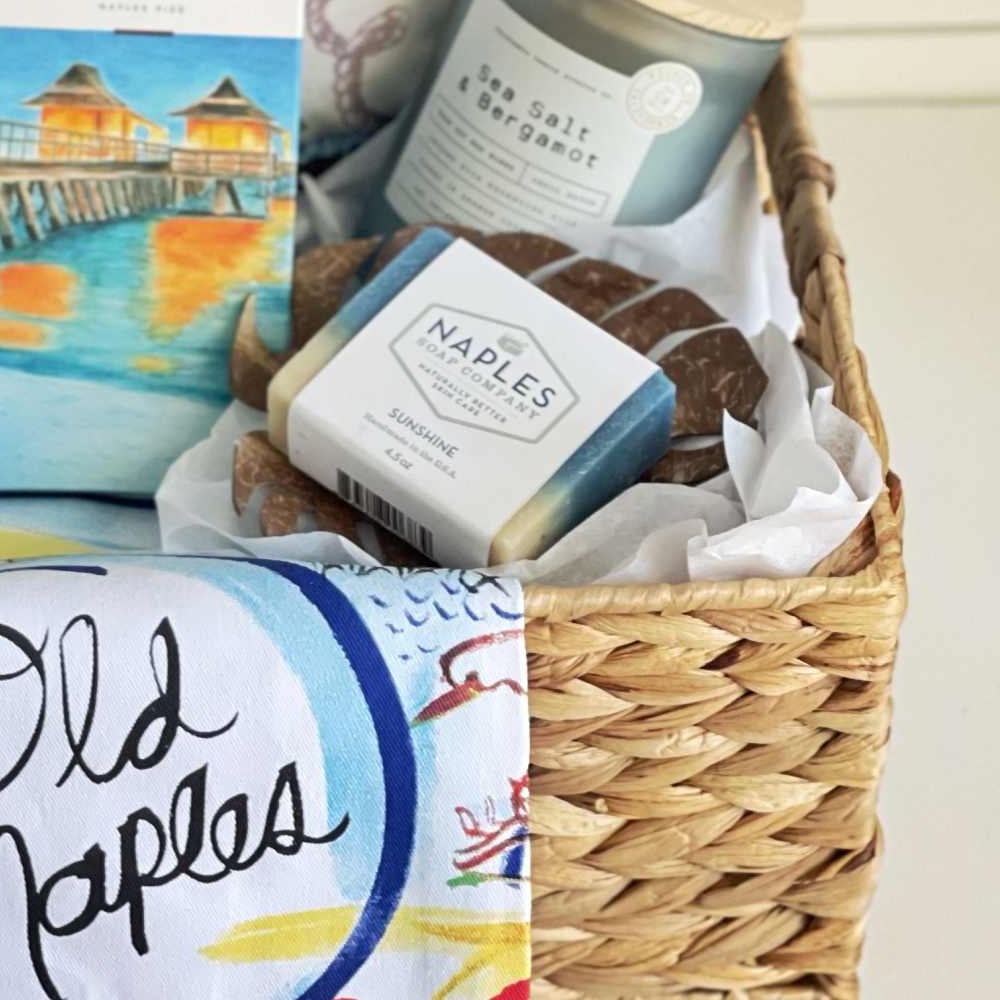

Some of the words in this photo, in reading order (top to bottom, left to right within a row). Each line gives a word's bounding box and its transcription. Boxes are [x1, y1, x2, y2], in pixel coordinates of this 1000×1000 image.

[476, 64, 516, 102] Sea
[528, 101, 592, 142] Salt
[477, 92, 599, 169] Bergamot
[416, 337, 460, 366] SOAP
[461, 365, 541, 421] COMPANY
[427, 317, 556, 409] NAPLES
[388, 407, 460, 458] SUNSHINE
